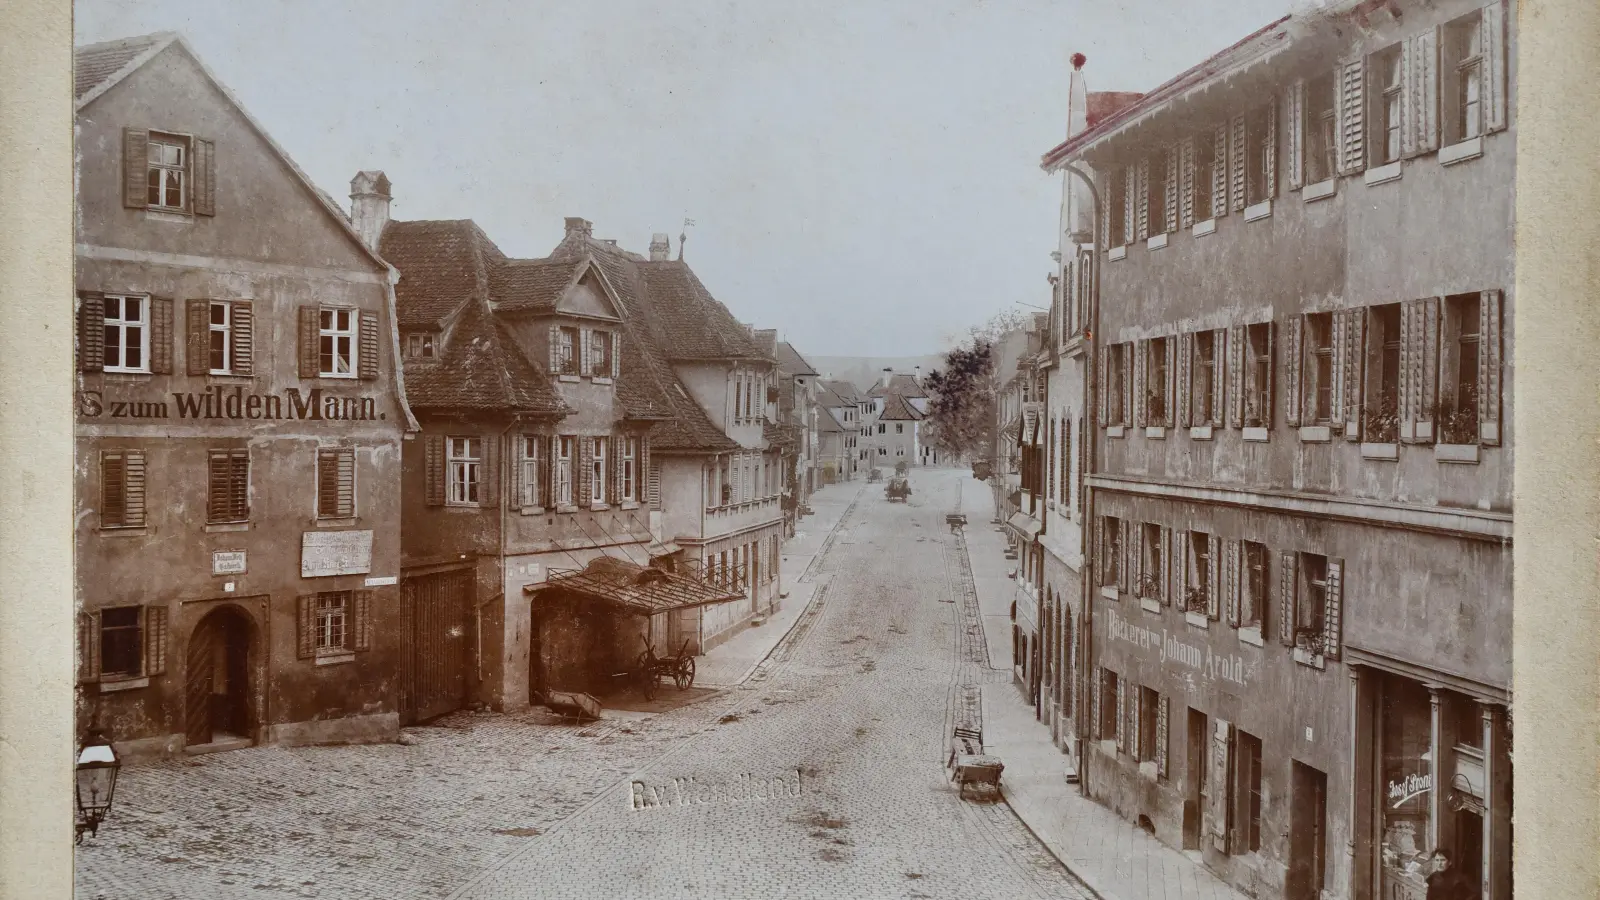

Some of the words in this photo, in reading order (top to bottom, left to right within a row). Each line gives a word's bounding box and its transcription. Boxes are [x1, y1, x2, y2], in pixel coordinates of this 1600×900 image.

[110, 401, 169, 419] zum
[285, 387, 387, 421] Mann.
[1160, 628, 1202, 671] Johann
